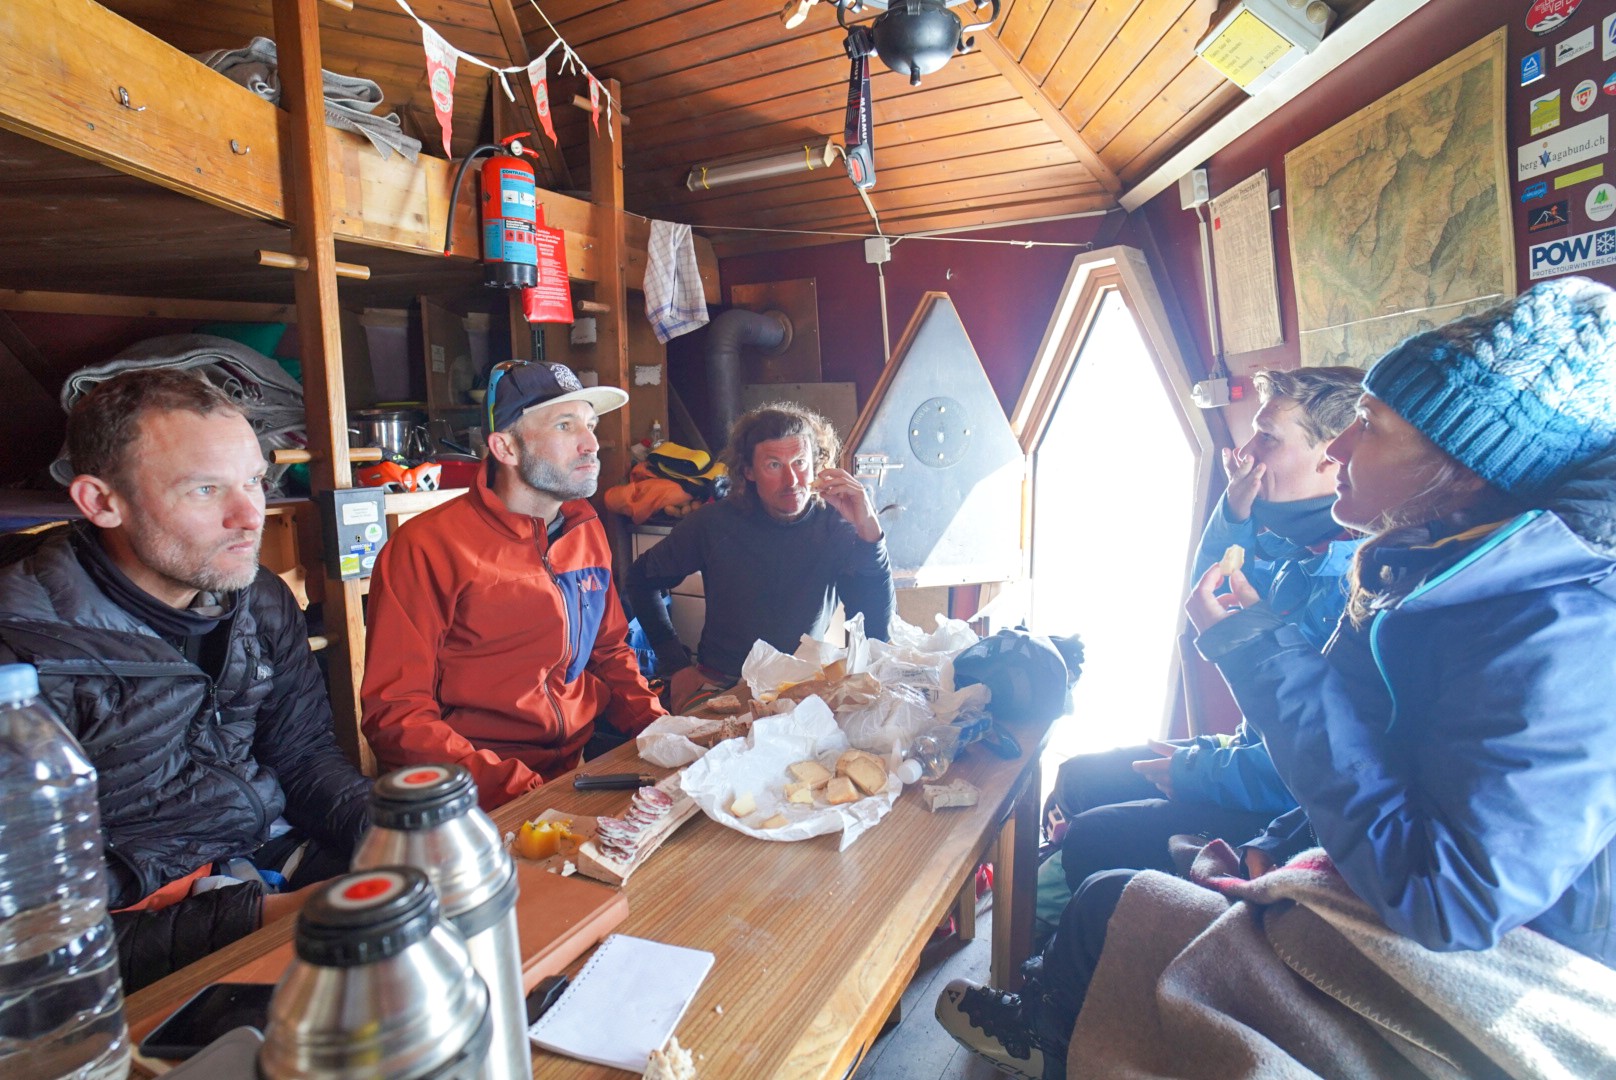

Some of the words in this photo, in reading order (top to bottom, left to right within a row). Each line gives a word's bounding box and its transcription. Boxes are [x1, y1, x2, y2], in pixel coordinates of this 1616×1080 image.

[1531, 118, 1560, 136] GUIDE
[1532, 235, 1594, 269] POW
[1532, 256, 1616, 277] PROTECTOURWINTERS.CH
